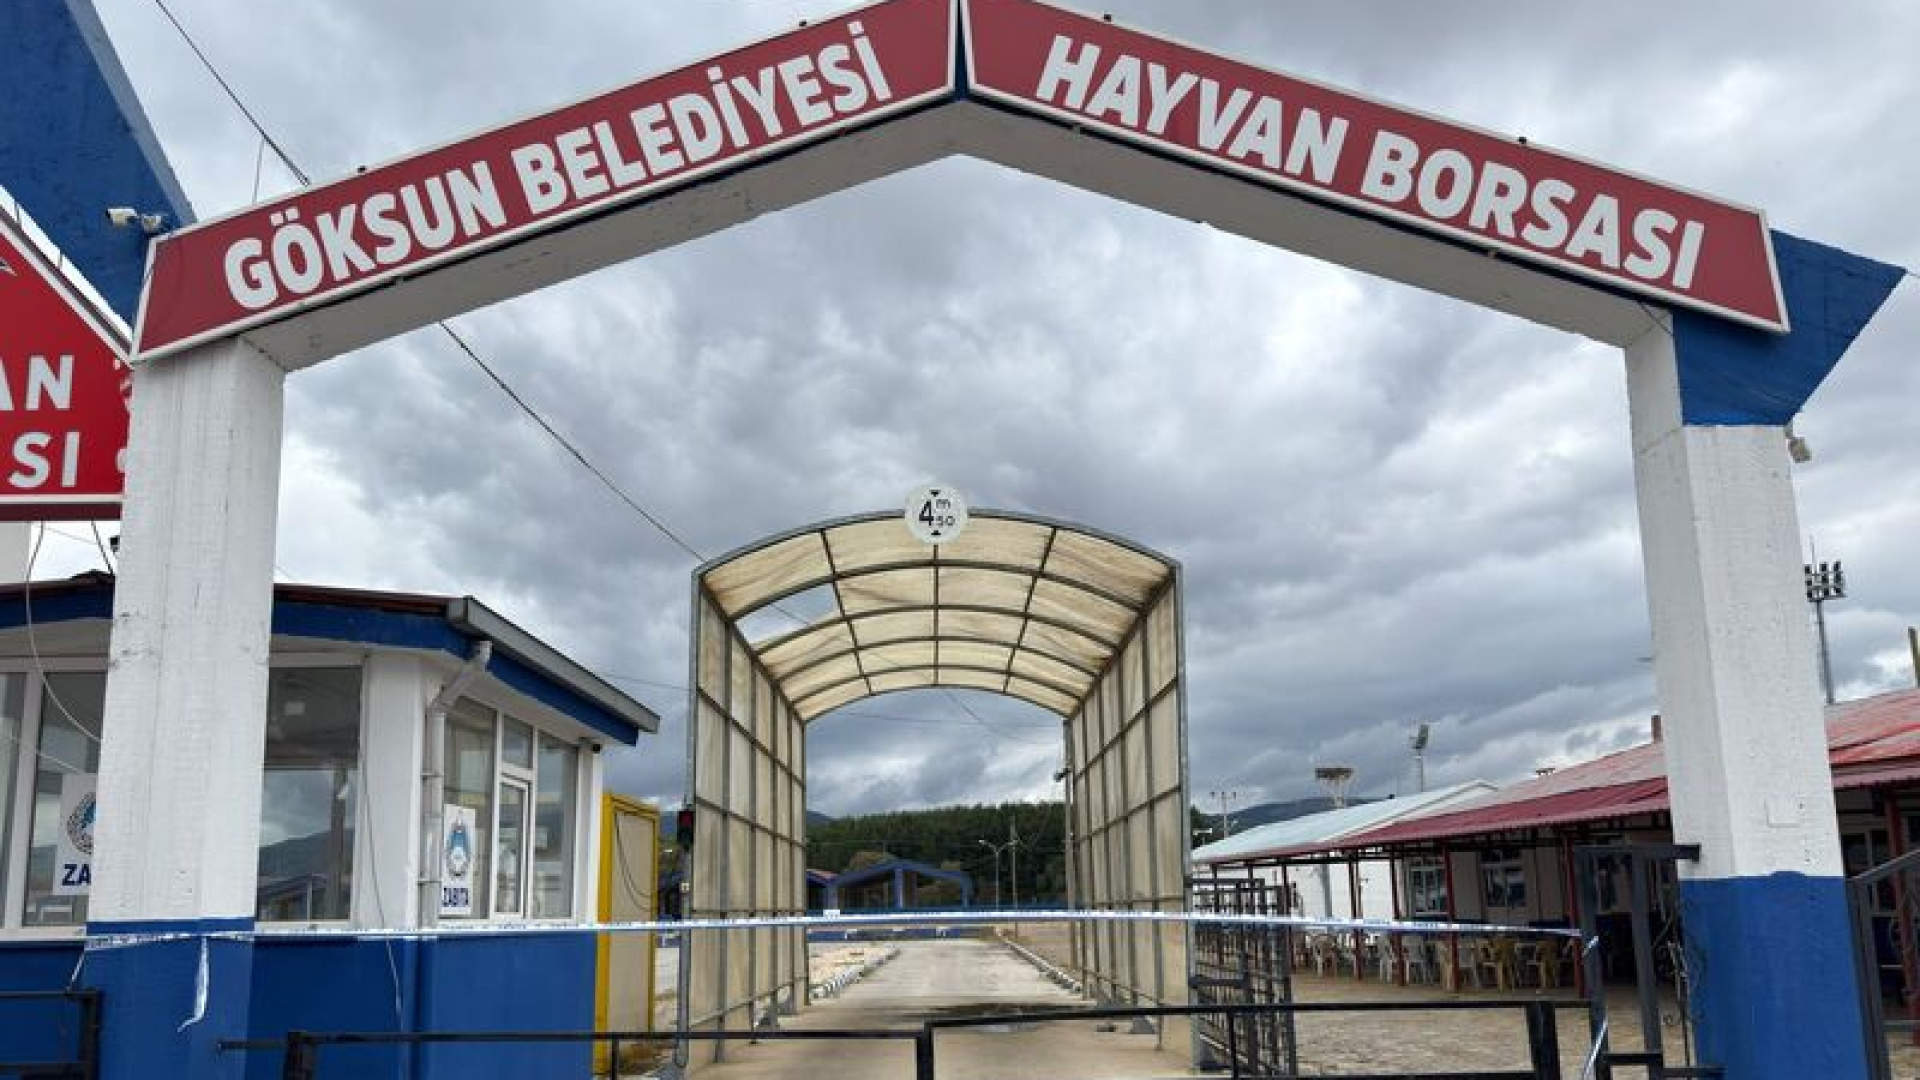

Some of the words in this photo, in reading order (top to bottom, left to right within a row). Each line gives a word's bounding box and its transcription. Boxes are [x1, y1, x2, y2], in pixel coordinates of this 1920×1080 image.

[224, 160, 507, 310] GÖKSUN
[510, 20, 892, 215] BELEDİYESİ
[1036, 35, 1350, 185] HAYVAN
[1361, 129, 1705, 289] BORSASI
[918, 499, 934, 527] 4
[62, 863, 92, 886] ZA
